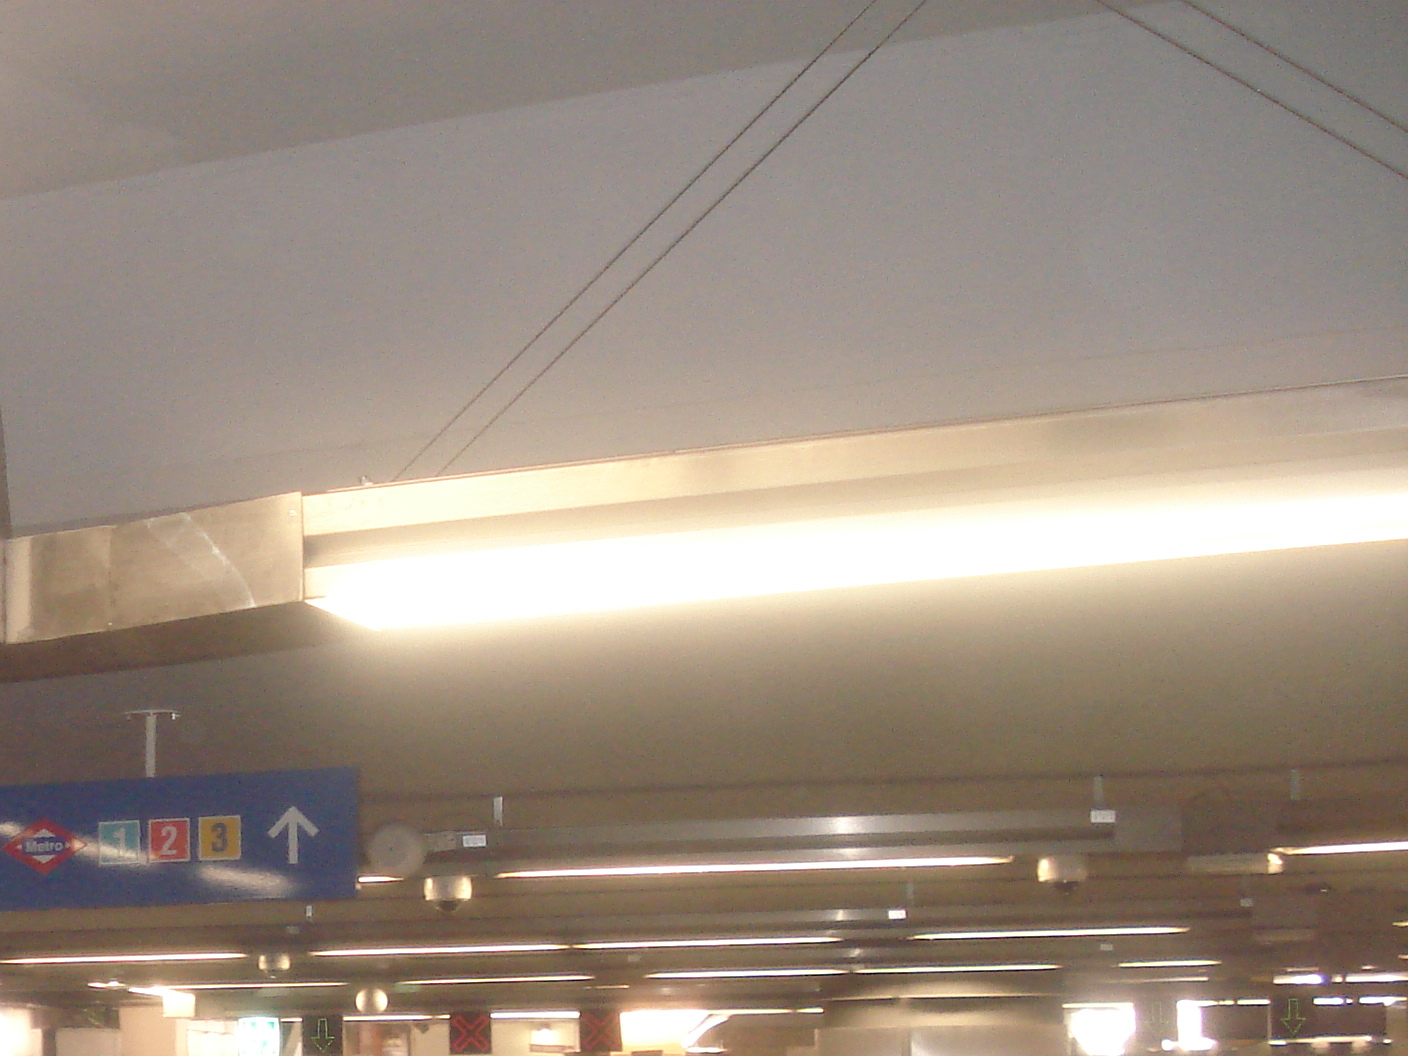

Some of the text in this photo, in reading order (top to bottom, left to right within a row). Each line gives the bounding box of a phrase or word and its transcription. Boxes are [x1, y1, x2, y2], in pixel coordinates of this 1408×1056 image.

[24, 822, 228, 858] Metro 1 2 3
